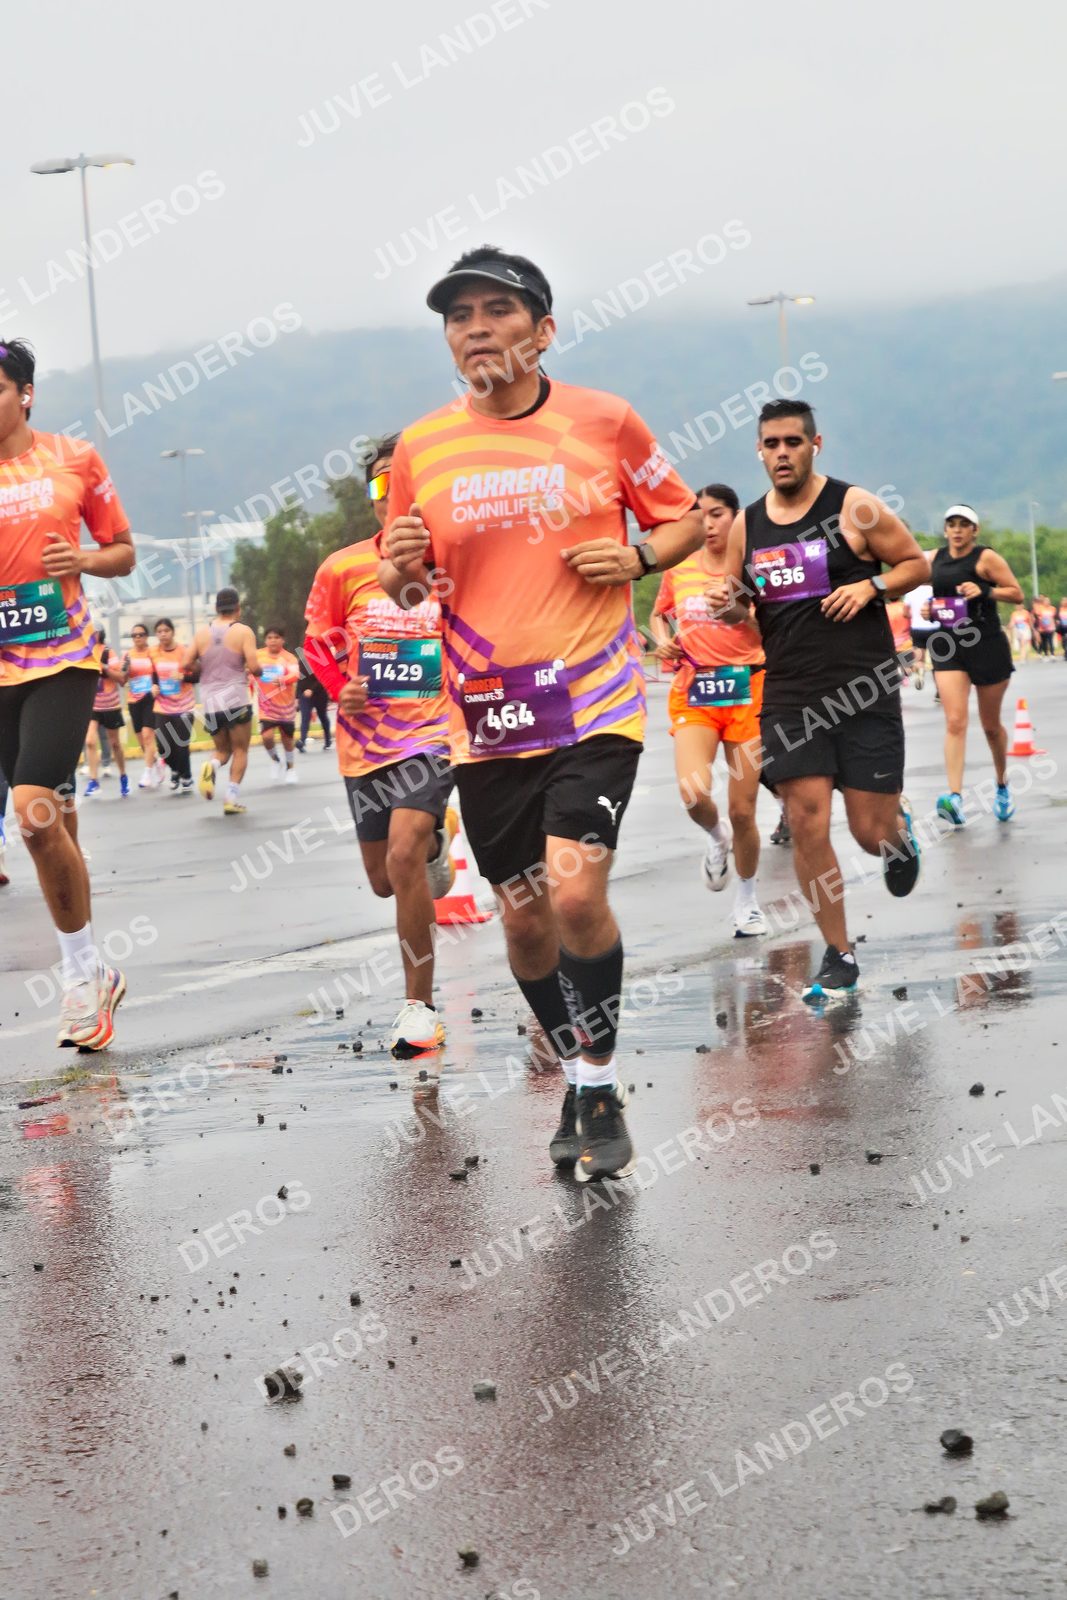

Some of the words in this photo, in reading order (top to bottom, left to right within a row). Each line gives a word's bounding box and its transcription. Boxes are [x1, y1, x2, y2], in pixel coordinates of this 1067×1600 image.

[451, 463, 565, 504] CARRERA
[451, 495, 538, 523] OMNILIFE
[770, 566, 805, 587] 636
[38, 583, 54, 597] 10K
[0, 605, 48, 628] 1279
[371, 663, 423, 681] 1429
[534, 668, 558, 687] 15K
[697, 679, 736, 694] 1317
[487, 703, 536, 730] 464
